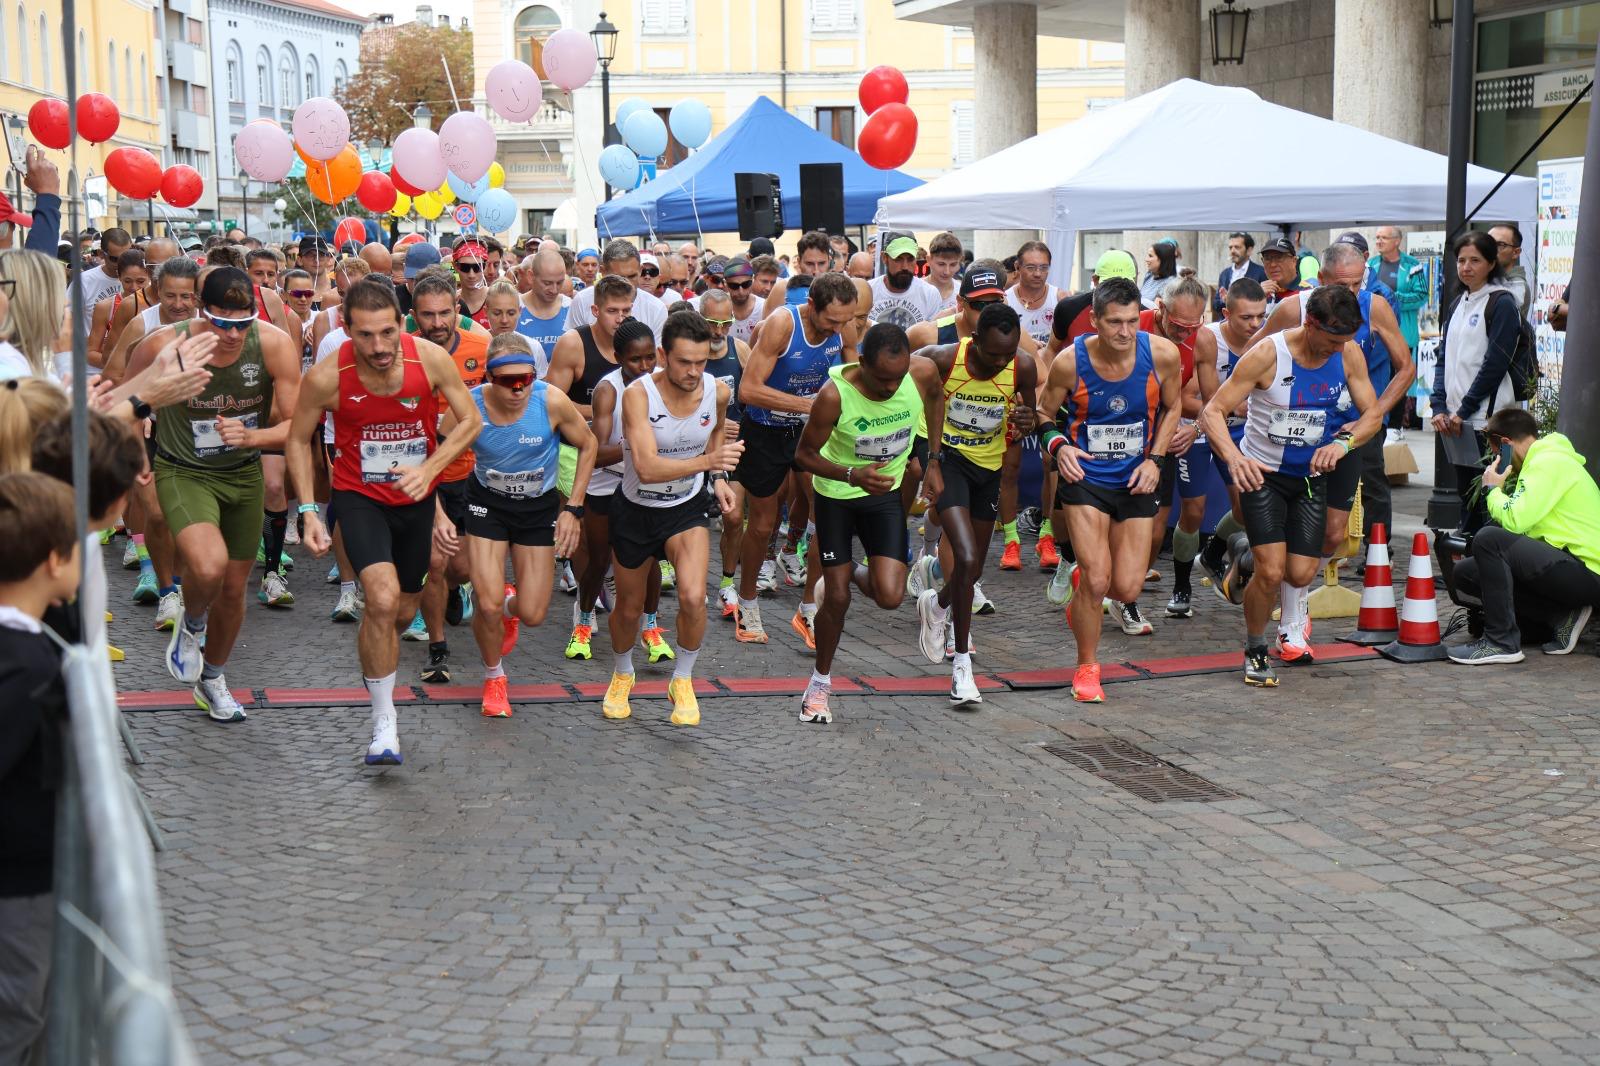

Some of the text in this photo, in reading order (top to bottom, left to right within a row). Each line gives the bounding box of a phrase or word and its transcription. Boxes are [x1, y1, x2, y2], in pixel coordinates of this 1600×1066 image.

[1562, 74, 1589, 87] BANCA
[955, 392, 1006, 403] DIADORA
[871, 410, 911, 427] TECNOCASA
[970, 417, 978, 425] 6
[1287, 427, 1306, 437] 142
[1107, 441, 1126, 451] 180
[881, 447, 889, 455] 5
[391, 461, 399, 469] 2
[505, 485, 525, 493] 313
[665, 485, 673, 493] 3
